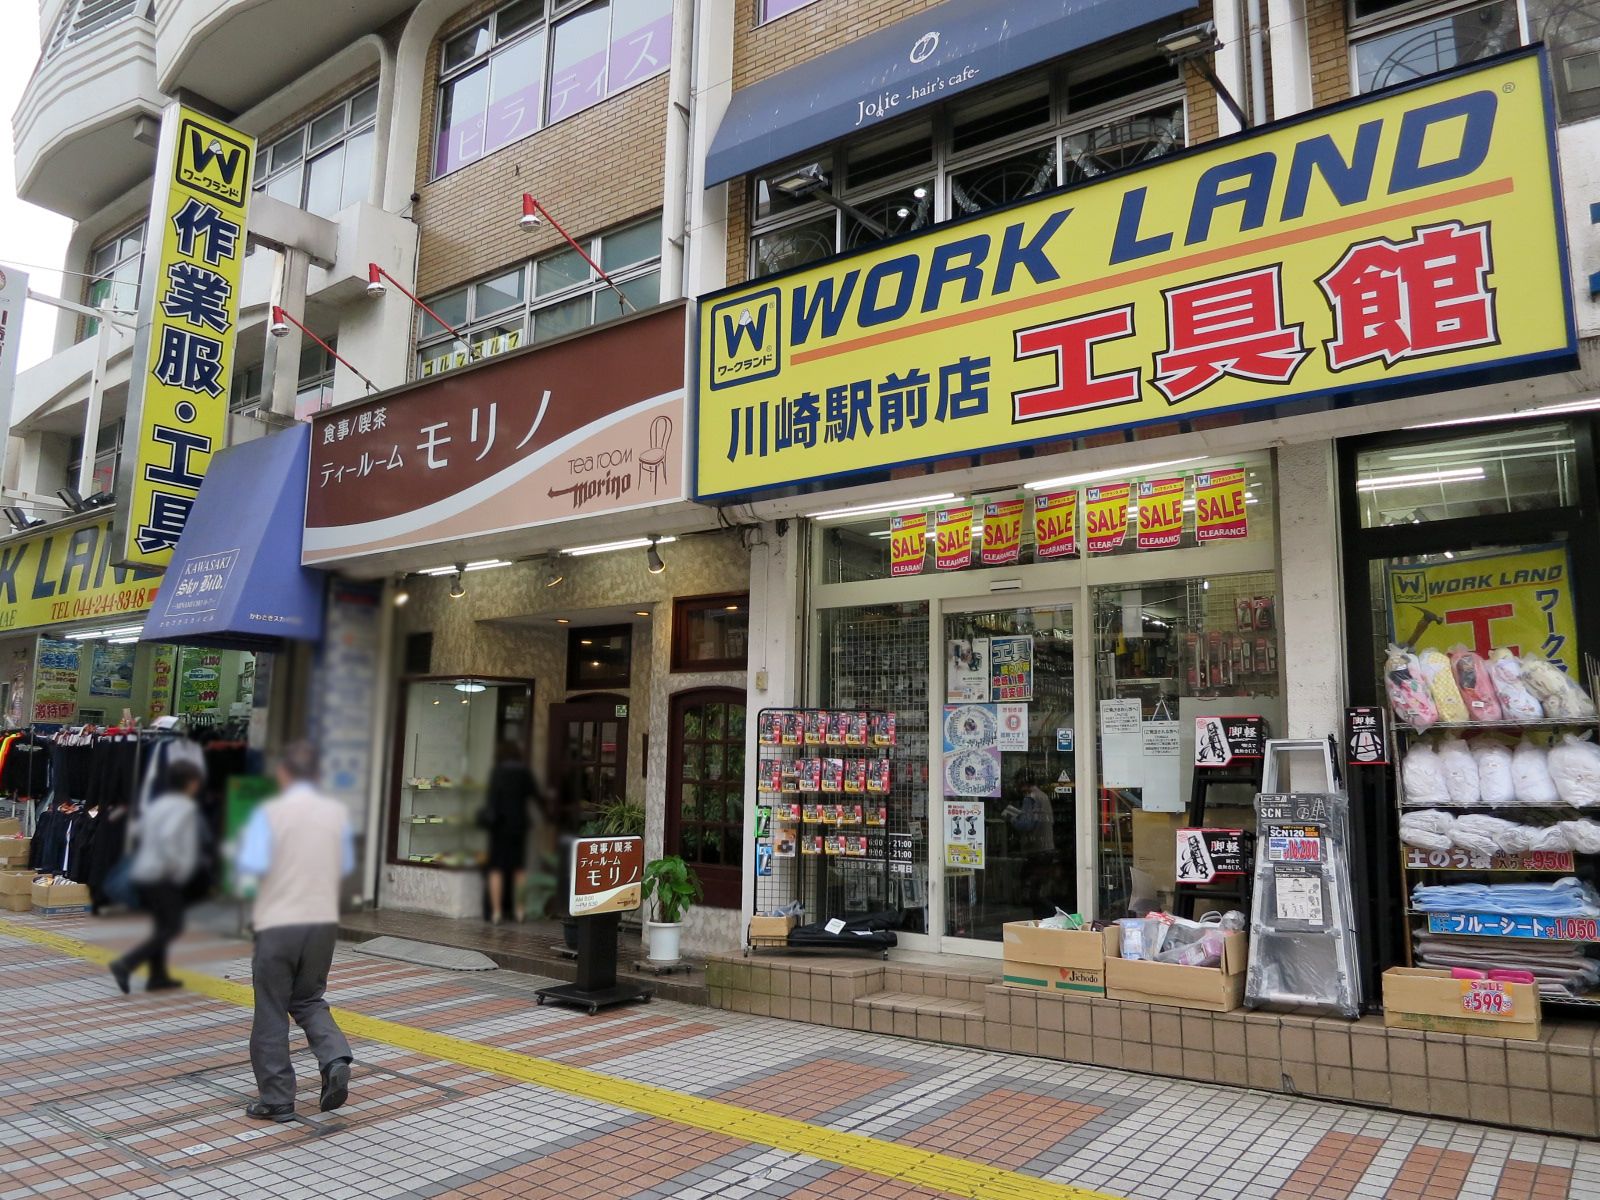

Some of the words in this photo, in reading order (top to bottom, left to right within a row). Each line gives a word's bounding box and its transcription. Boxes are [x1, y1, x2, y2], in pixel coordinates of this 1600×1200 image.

[457, 31, 659, 161] ピラティス
[855, 91, 900, 125] Jolie
[183, 168, 239, 197] ワークランド
[789, 207, 1076, 347] WORK
[1108, 89, 1499, 267] LAND
[726, 354, 992, 465] 川崎駅前店
[1011, 219, 1502, 425] 工具館
[717, 353, 773, 376] ワークランド
[323, 406, 388, 445] 食事/喫茶
[320, 444, 404, 488] ティールーム
[416, 389, 552, 471] モリノ
[1087, 504, 1127, 534] SALE
[1139, 499, 1182, 530] SALE
[1197, 490, 1246, 523] SALE
[983, 519, 1021, 546] SALE
[1036, 510, 1073, 542] SALE
[1198, 526, 1246, 538] CLEARANCE
[892, 532, 925, 559] SALE
[937, 525, 970, 553] SALE
[1039, 542, 1073, 556] CLEARANCE
[185, 555, 232, 575] KAWASAKI
[1428, 574, 1493, 595] WORK
[1499, 564, 1563, 586] LAND
[51, 600, 71, 621] TEL
[993, 639, 1031, 664] 工具
[1260, 807, 1282, 818] SCN
[892, 839, 912, 848] 21:00
[1269, 829, 1305, 837] SCN120
[589, 841, 633, 855] 食事/喫茶
[892, 850, 912, 859] 21:00
[1523, 850, 1570, 870] ¥950
[580, 855, 621, 867] ティールーム
[586, 865, 638, 886] モリノ
[1450, 915, 1544, 937] ブルーシート
[1463, 992, 1504, 1012] ¥599
